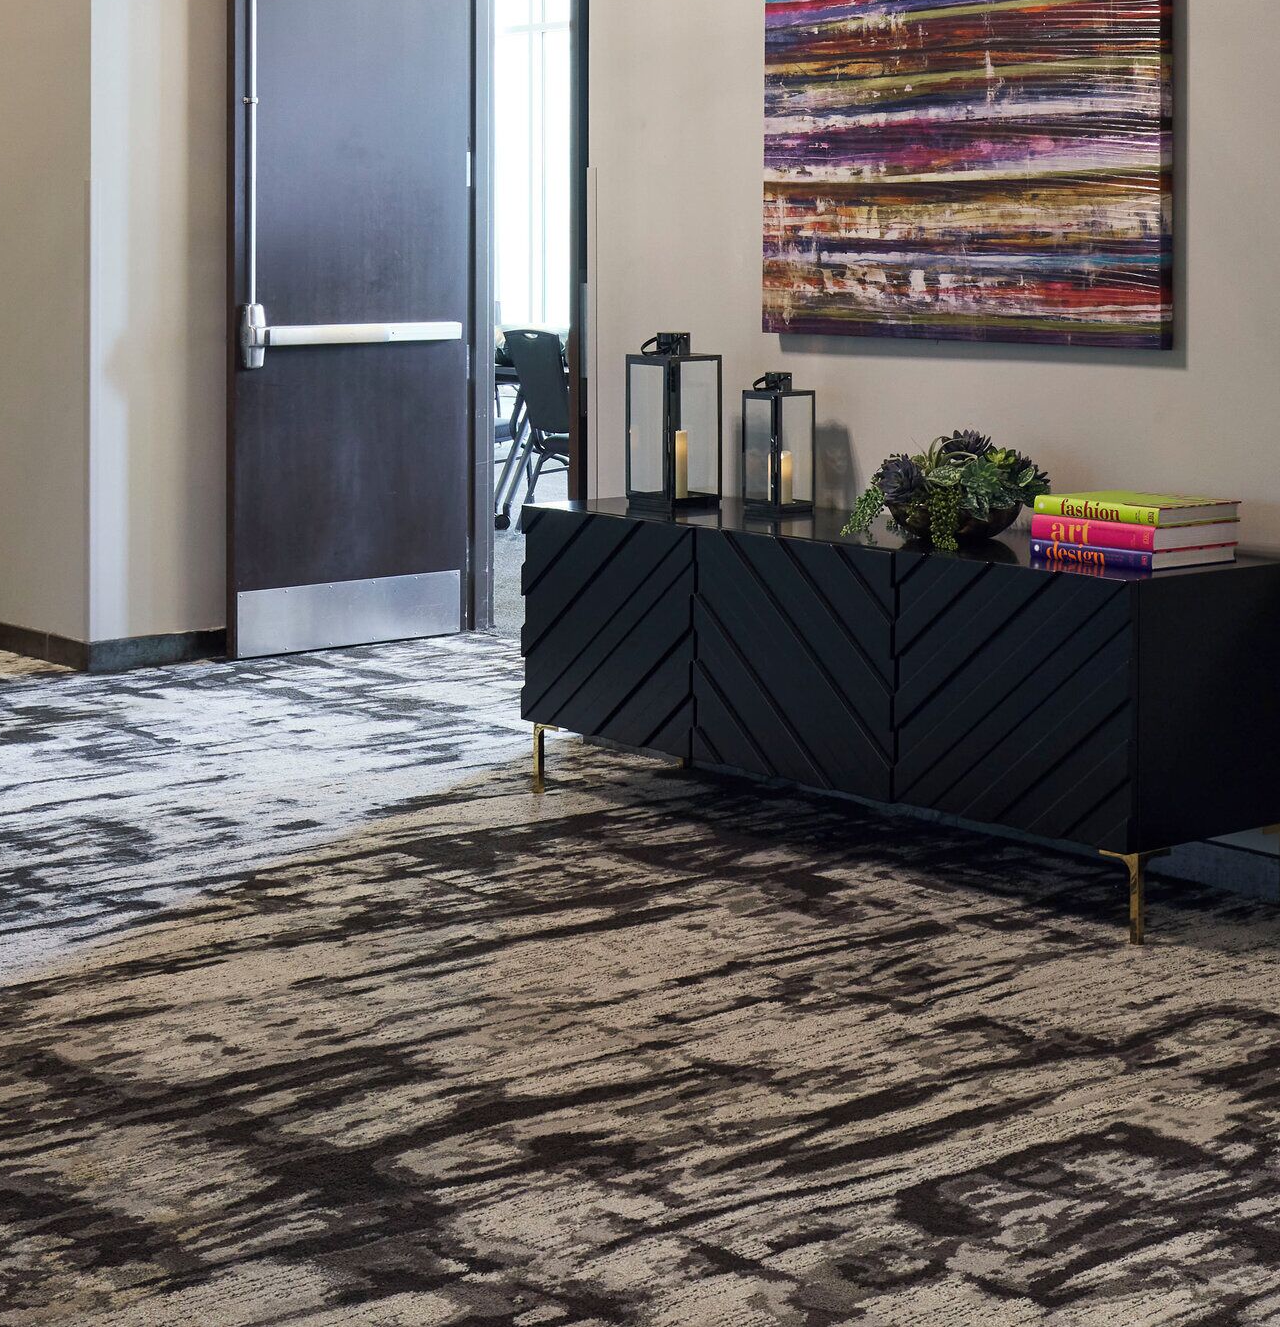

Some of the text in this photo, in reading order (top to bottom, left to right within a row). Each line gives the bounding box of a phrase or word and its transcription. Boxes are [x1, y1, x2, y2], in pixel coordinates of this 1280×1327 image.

[1060, 499, 1120, 521] fashion
[1051, 521, 1090, 544] art
[1046, 541, 1105, 566] design
